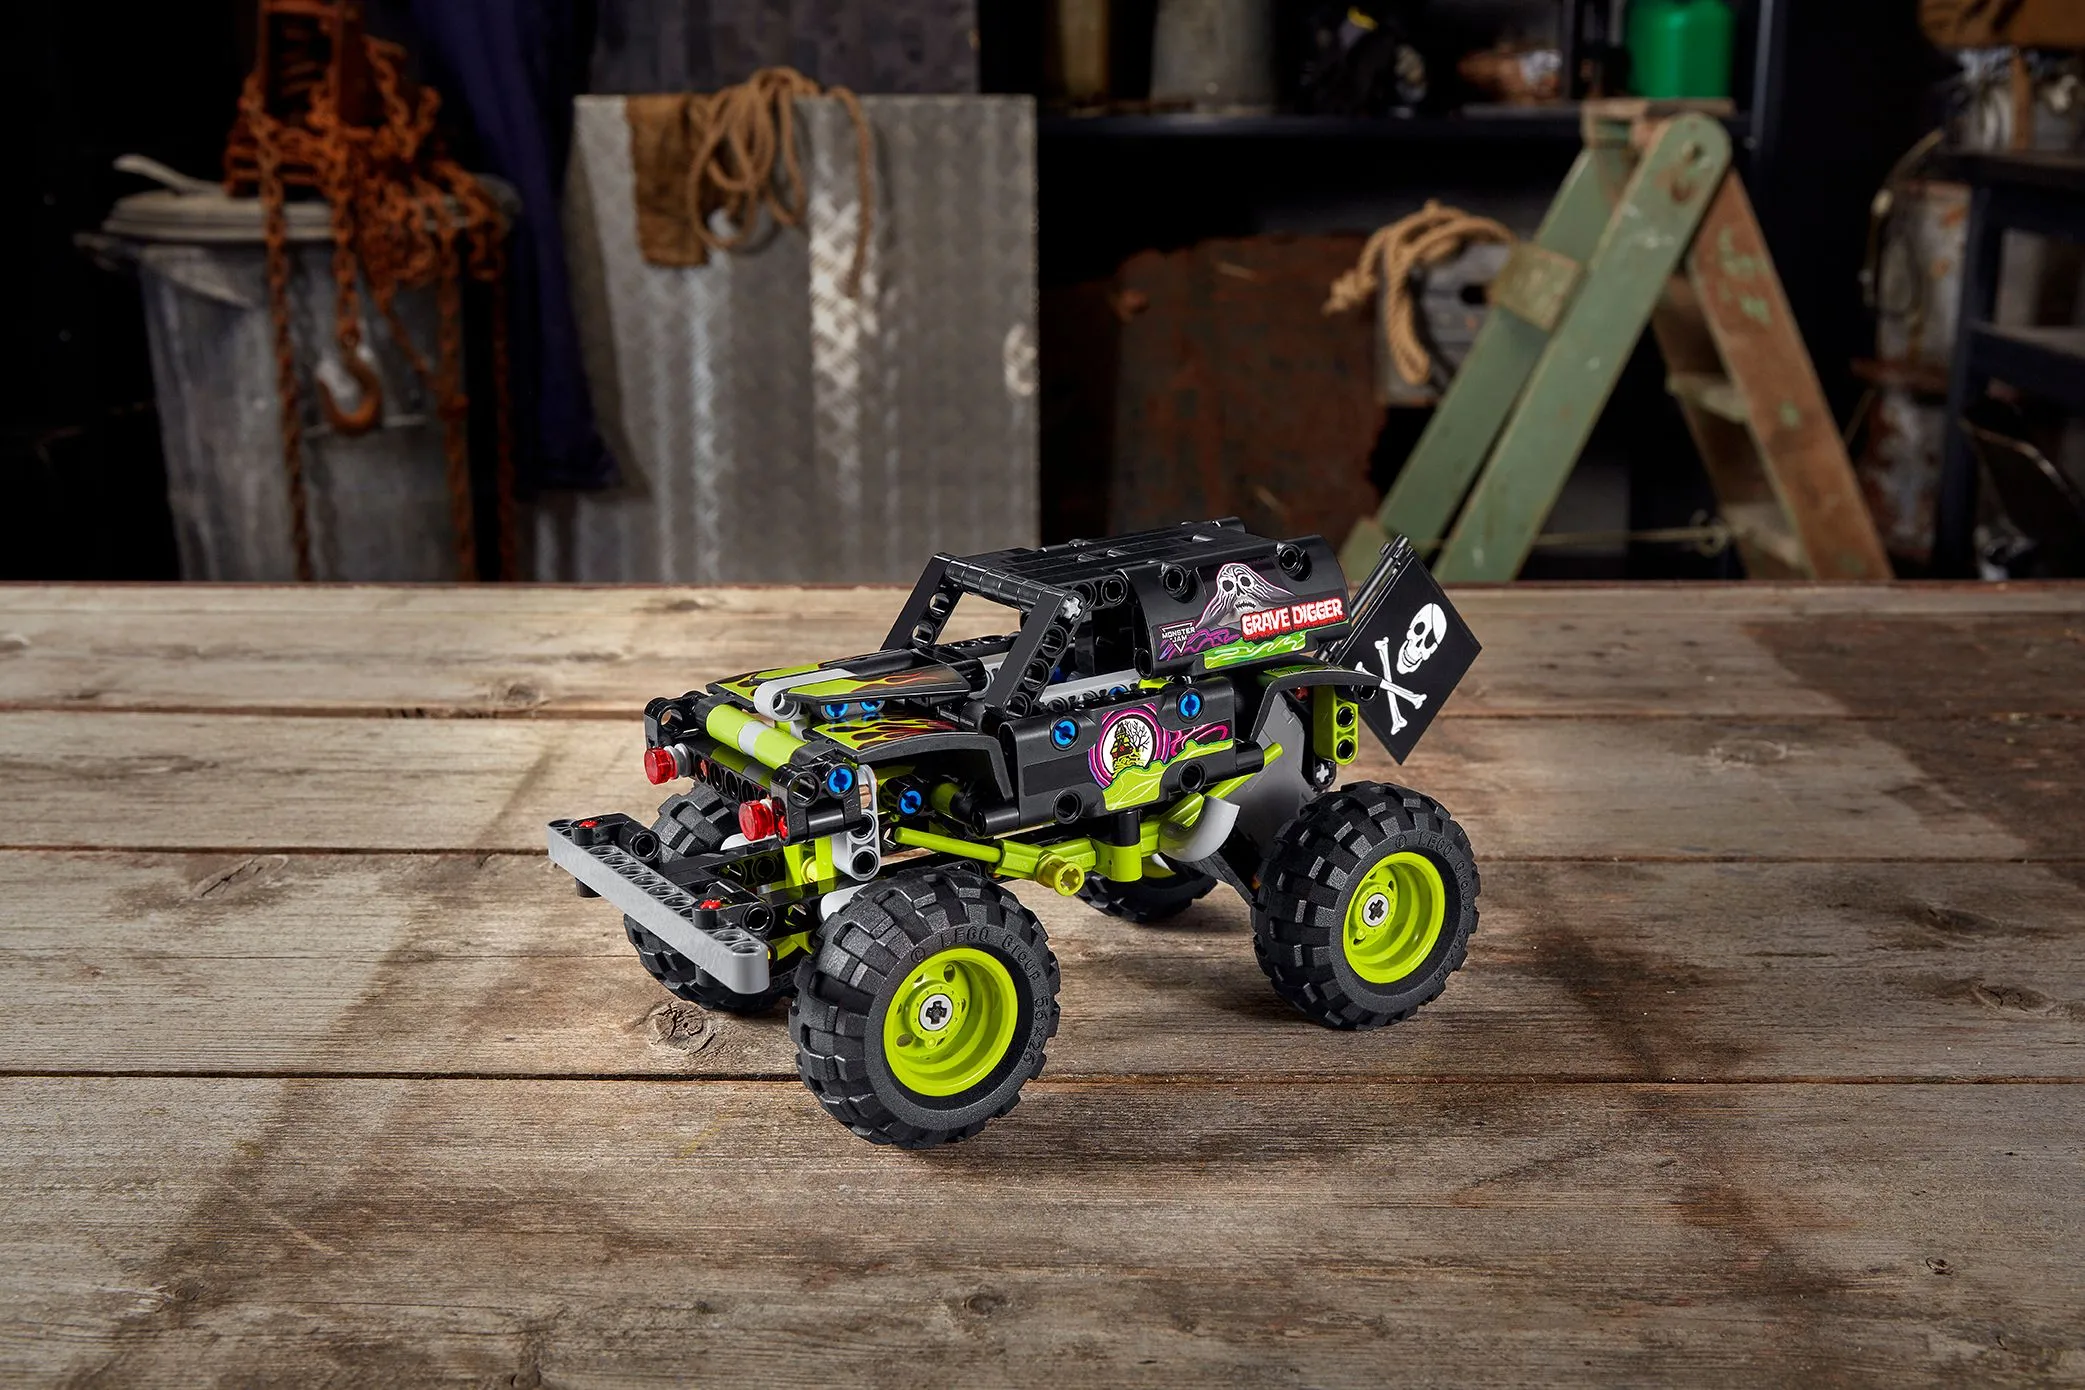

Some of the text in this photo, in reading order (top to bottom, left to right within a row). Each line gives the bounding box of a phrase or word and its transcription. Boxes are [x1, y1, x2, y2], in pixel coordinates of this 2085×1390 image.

[1241, 598, 1343, 636] GRAVE DIGGER
[1161, 626, 1196, 640] MONSTER
[1172, 634, 1188, 643] JAM
[1418, 831, 1453, 858] LEGO
[940, 925, 989, 949] LEGO
[1001, 933, 1040, 981] Group
